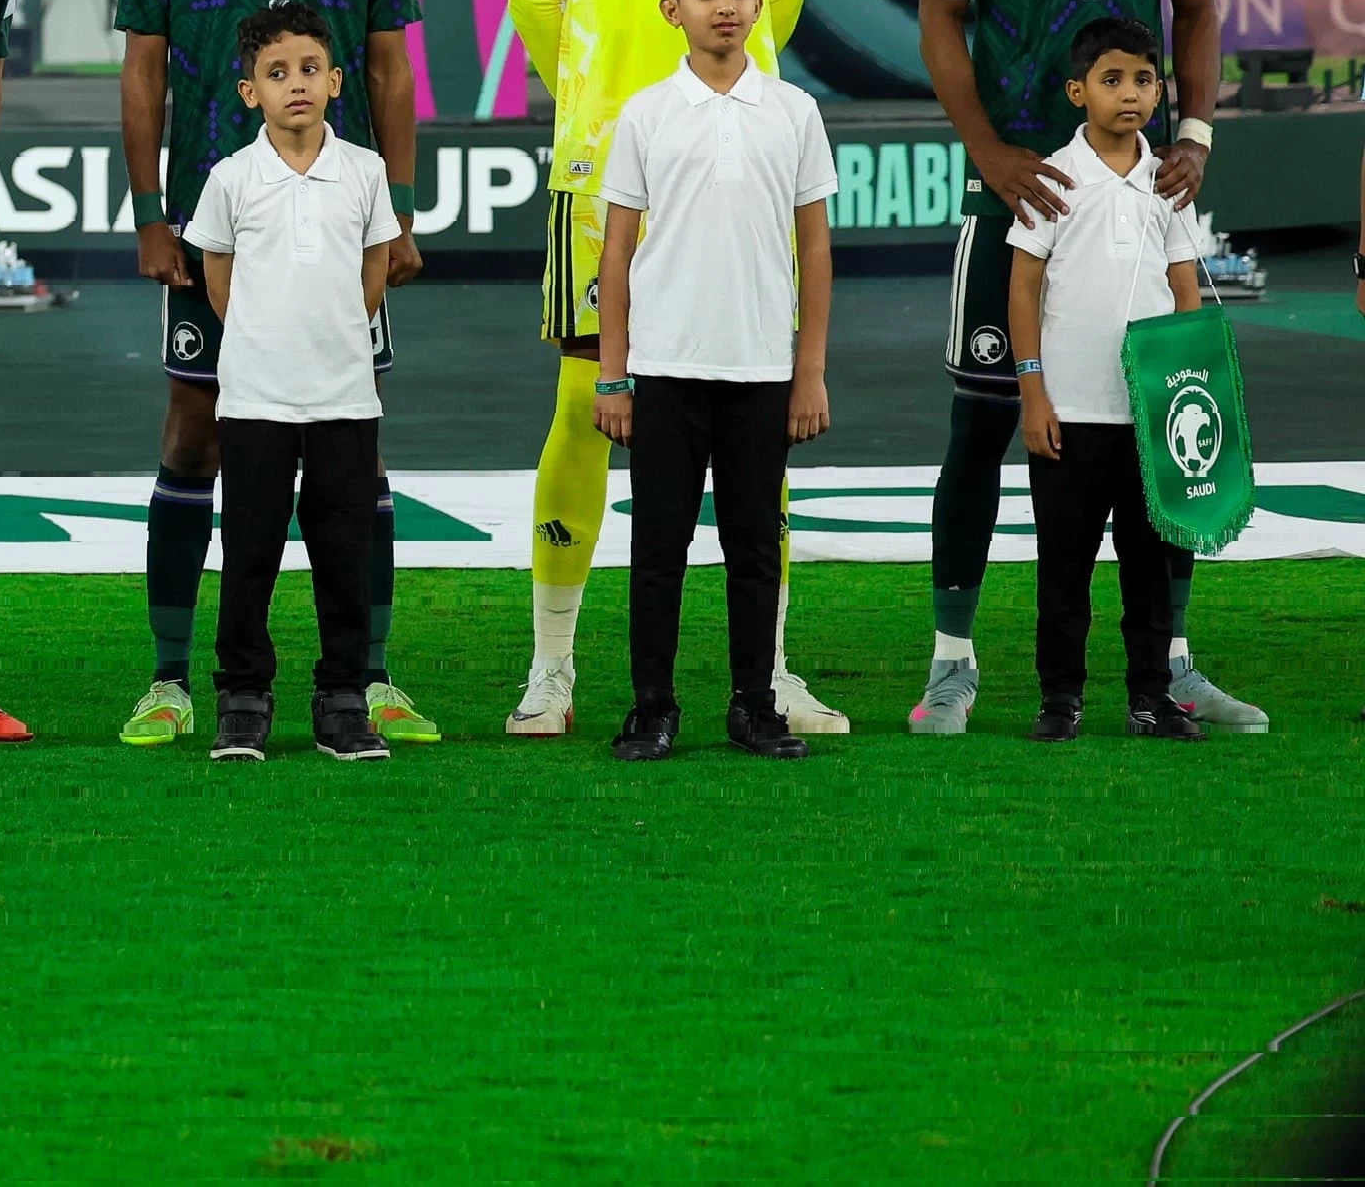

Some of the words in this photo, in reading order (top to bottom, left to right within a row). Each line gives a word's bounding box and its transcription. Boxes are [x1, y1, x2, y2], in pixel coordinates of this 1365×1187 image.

[824, 142, 966, 228] RABI
[1165, 369, 1209, 389] السعودية
[1197, 437, 1213, 448] SAFF
[1186, 481, 1216, 500] SAUDI
